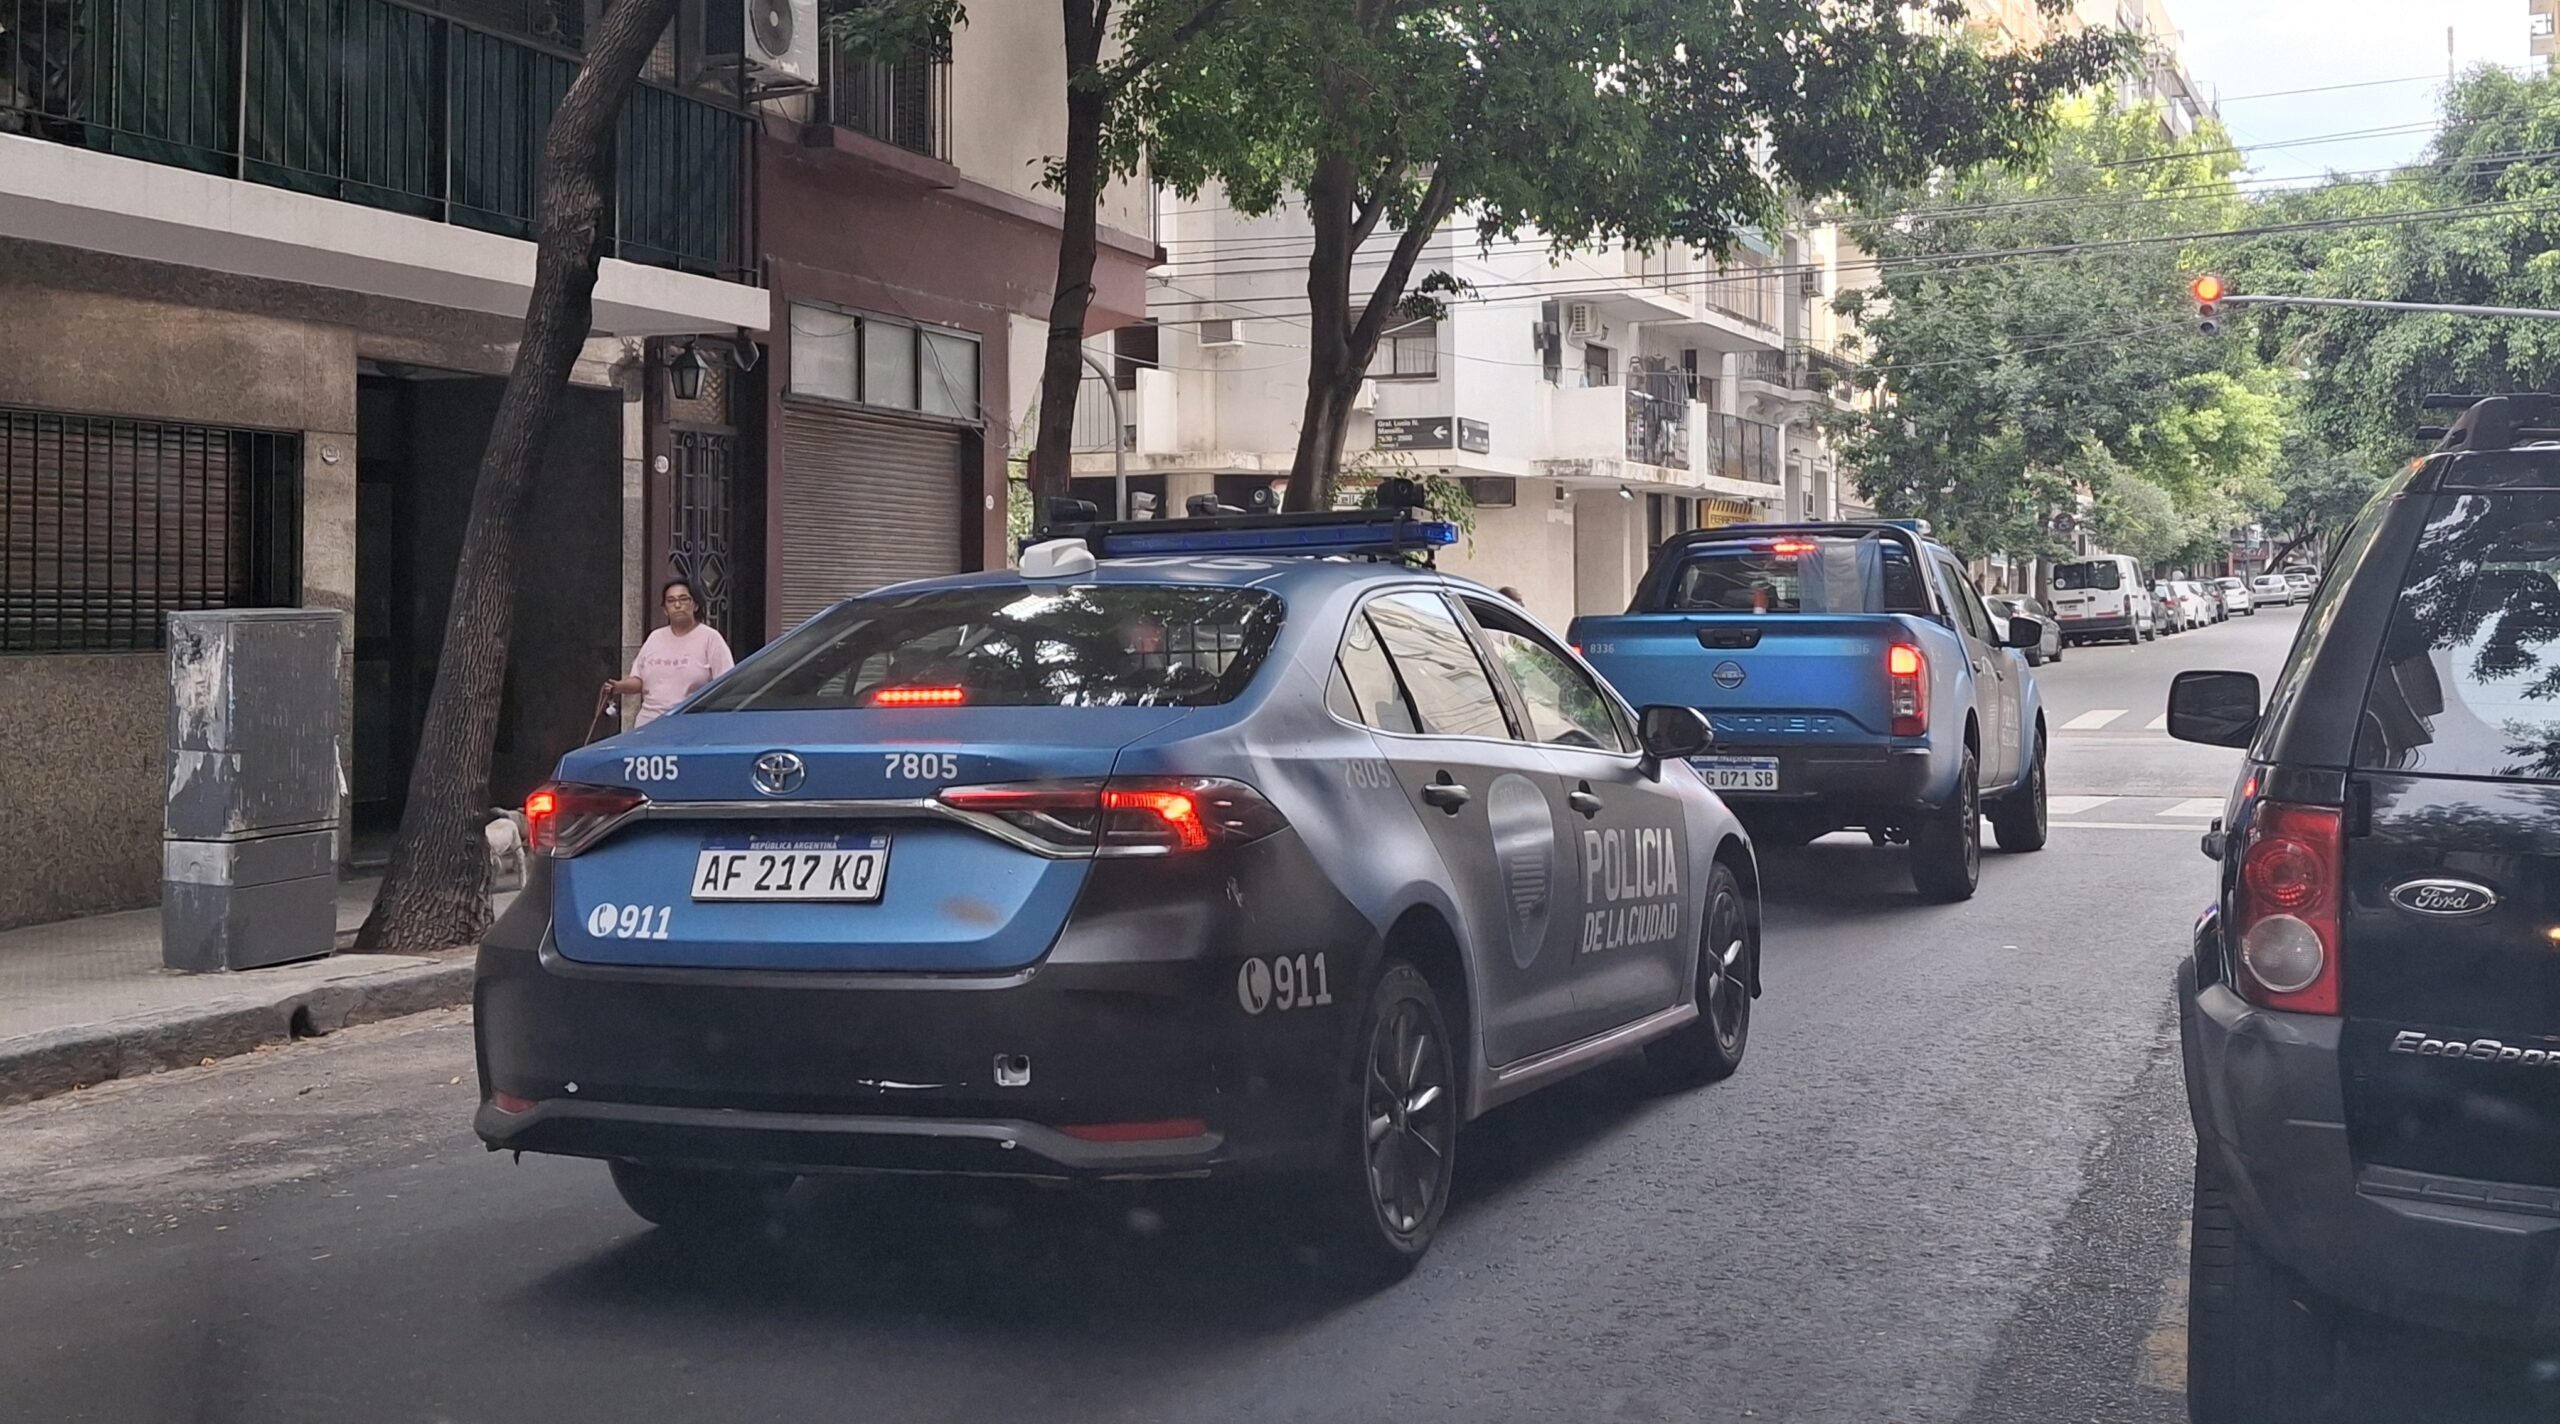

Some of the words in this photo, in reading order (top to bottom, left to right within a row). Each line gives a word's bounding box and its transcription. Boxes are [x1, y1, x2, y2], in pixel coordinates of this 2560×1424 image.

[1589, 643, 1615, 654] 8336
[623, 755, 679, 782] 7805
[884, 753, 958, 779] 7805
[1342, 758, 1392, 790] 7805
[1720, 771, 1749, 787] 071
[1754, 771, 1773, 787] SB
[750, 839, 792, 850] REPÚBLICA
[793, 841, 837, 850] ARGENTINA
[701, 855, 747, 891] AF
[754, 855, 821, 891] 217
[829, 855, 874, 891] KQ
[1583, 828, 1678, 903] POLICIA
[2415, 886, 2470, 909] Ford
[616, 904, 672, 939] 911
[1582, 911, 1604, 952] DE
[1605, 907, 1624, 948] LA
[1624, 901, 1677, 945] CIUDAD
[1273, 951, 1332, 1010] 911
[2389, 1030, 2560, 1067] EcoSpor
